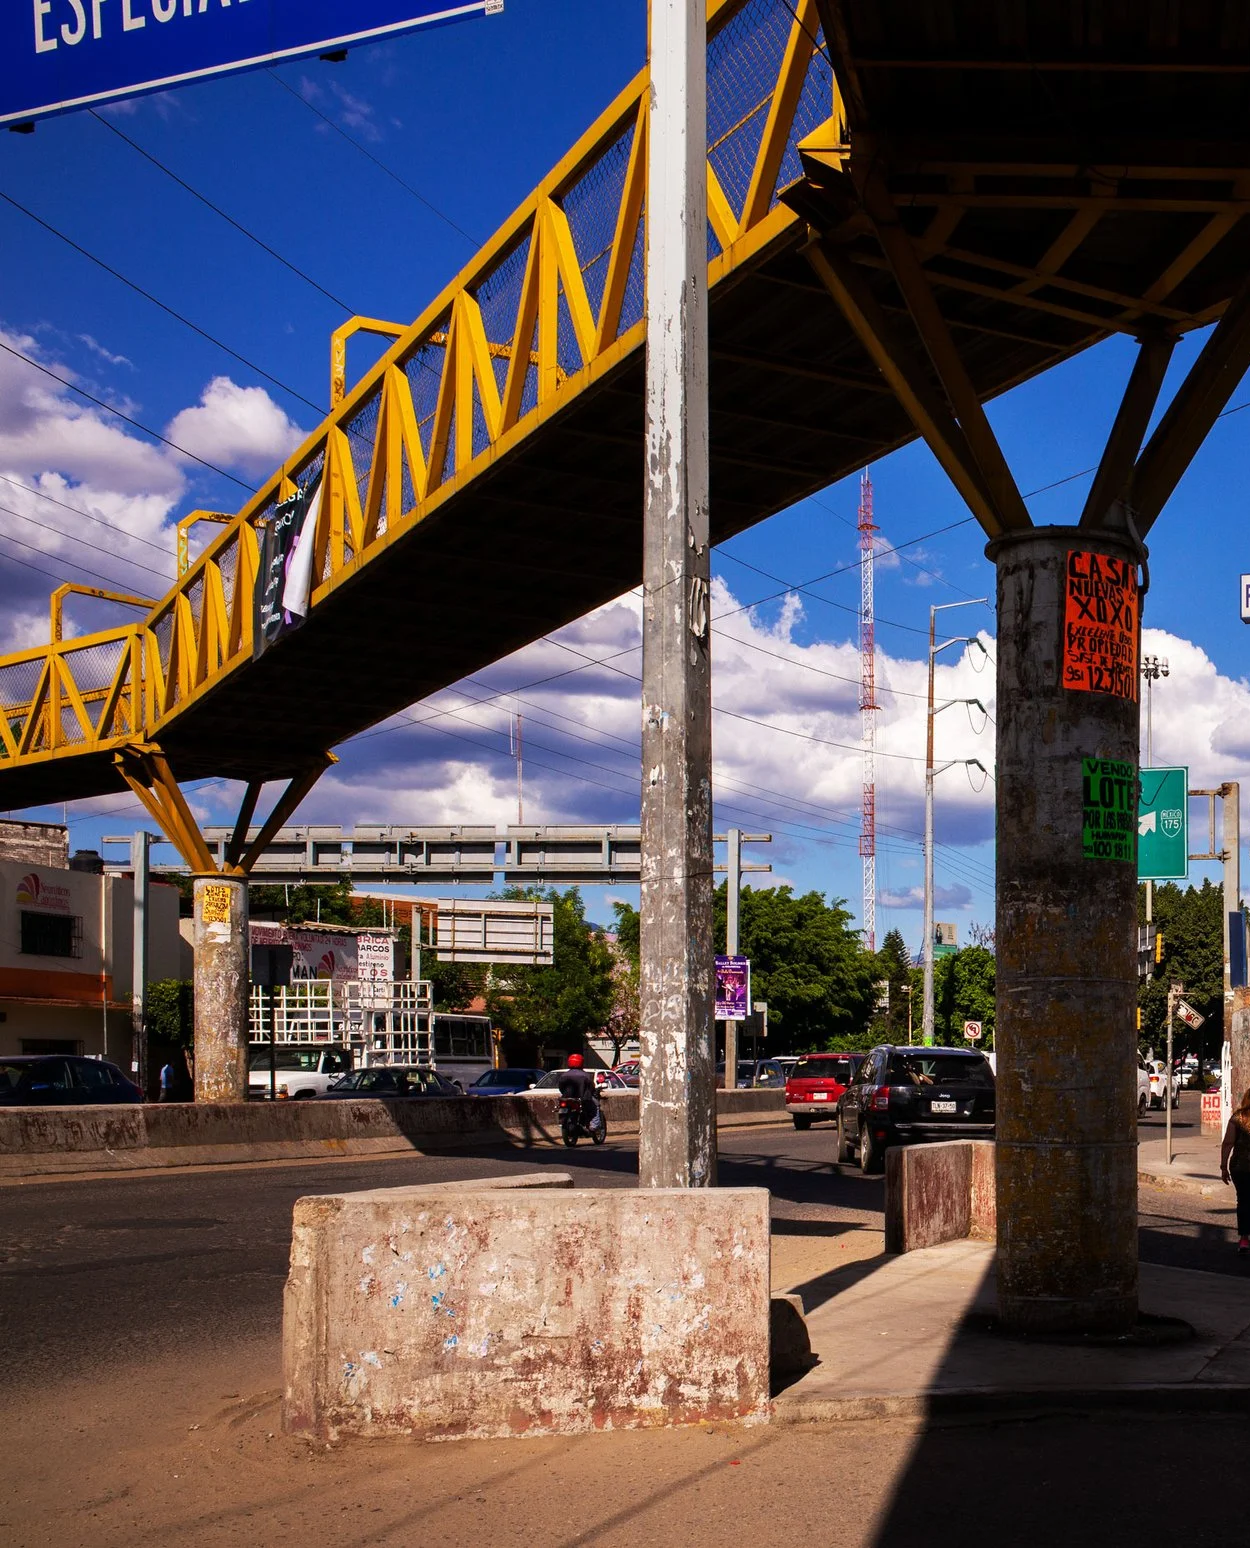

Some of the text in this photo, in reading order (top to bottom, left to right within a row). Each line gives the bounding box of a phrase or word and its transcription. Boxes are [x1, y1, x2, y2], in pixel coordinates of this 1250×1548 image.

[1068, 550, 1138, 595] CASAS
[1069, 579, 1125, 605] NUEVAS
[1072, 596, 1134, 633] XOXO
[1067, 634, 1134, 664] PROPIEDAD
[1086, 760, 1133, 778] VENDO
[1083, 775, 1135, 811] LOTE
[1083, 809, 1100, 829] POR
[1164, 819, 1179, 829] 175
[356, 935, 390, 945] BRICA
